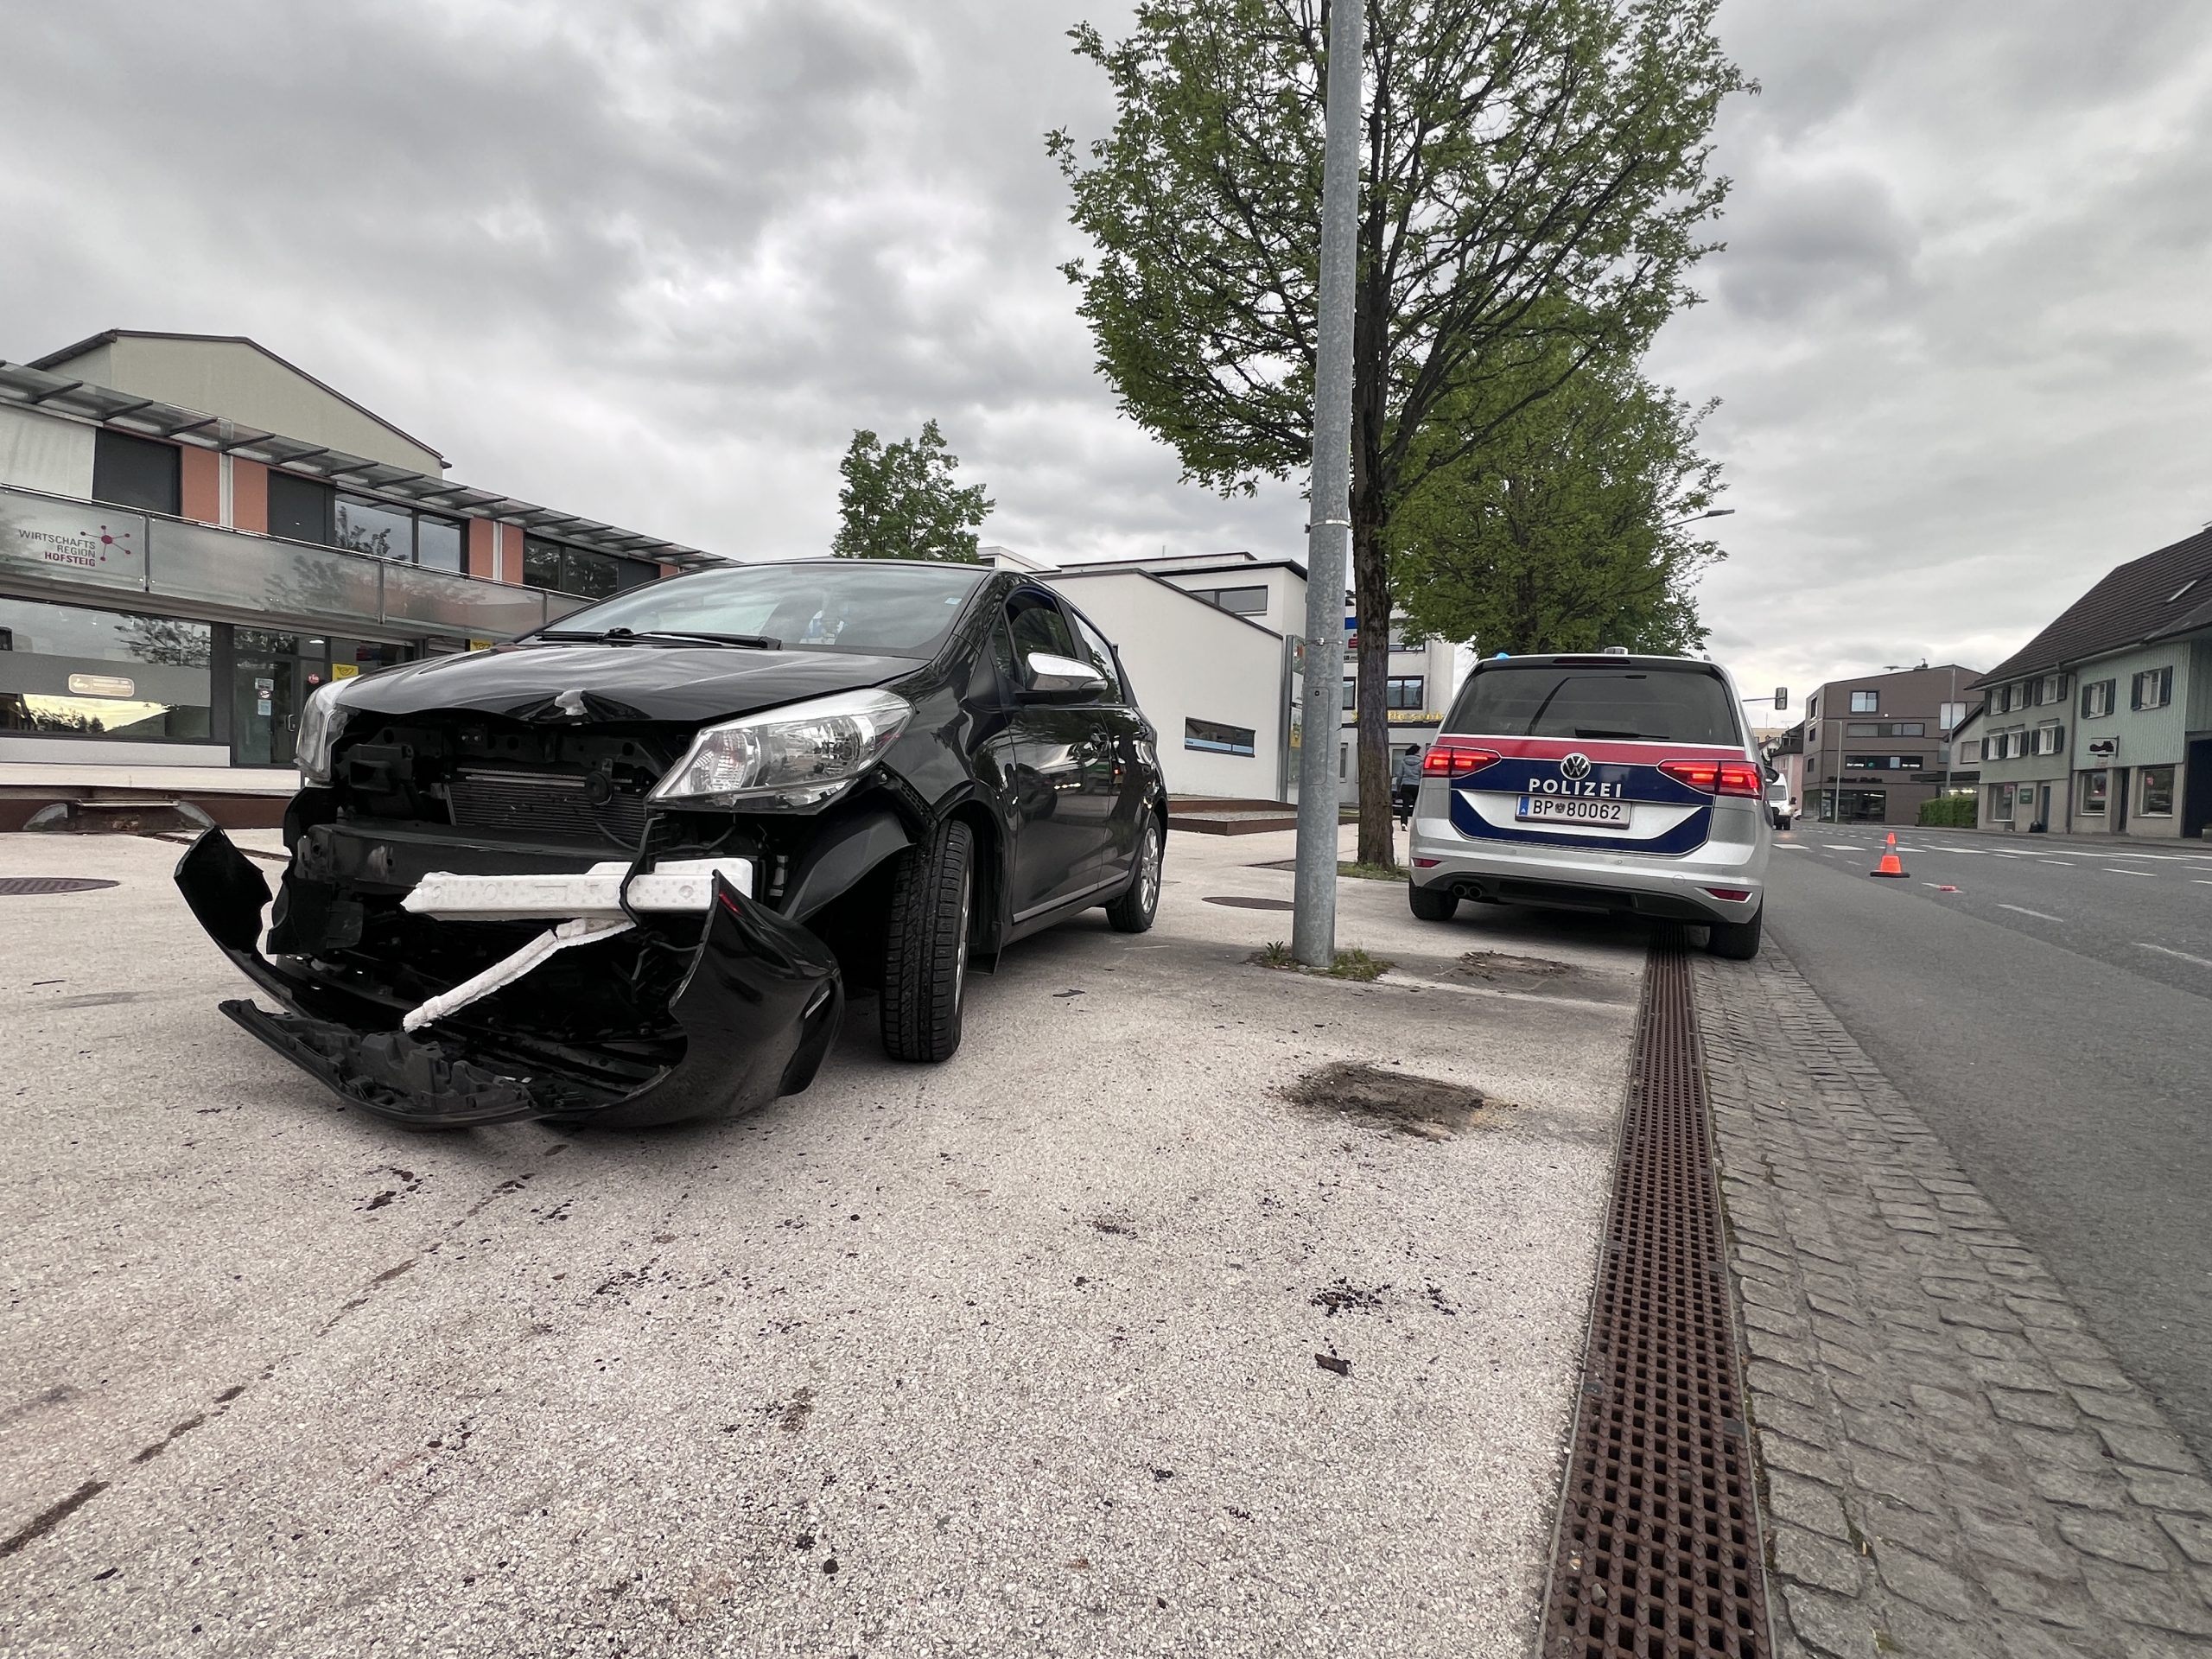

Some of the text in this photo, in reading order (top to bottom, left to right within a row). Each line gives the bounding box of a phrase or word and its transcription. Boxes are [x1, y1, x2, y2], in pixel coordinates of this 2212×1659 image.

[18, 529, 96, 550] WIRTSCHAFTS
[44, 551, 96, 567] HOFSTEIG
[56, 544, 96, 558] REGION
[1528, 778, 1622, 798] POLIZEI
[1533, 799, 1621, 820] BP 80062
